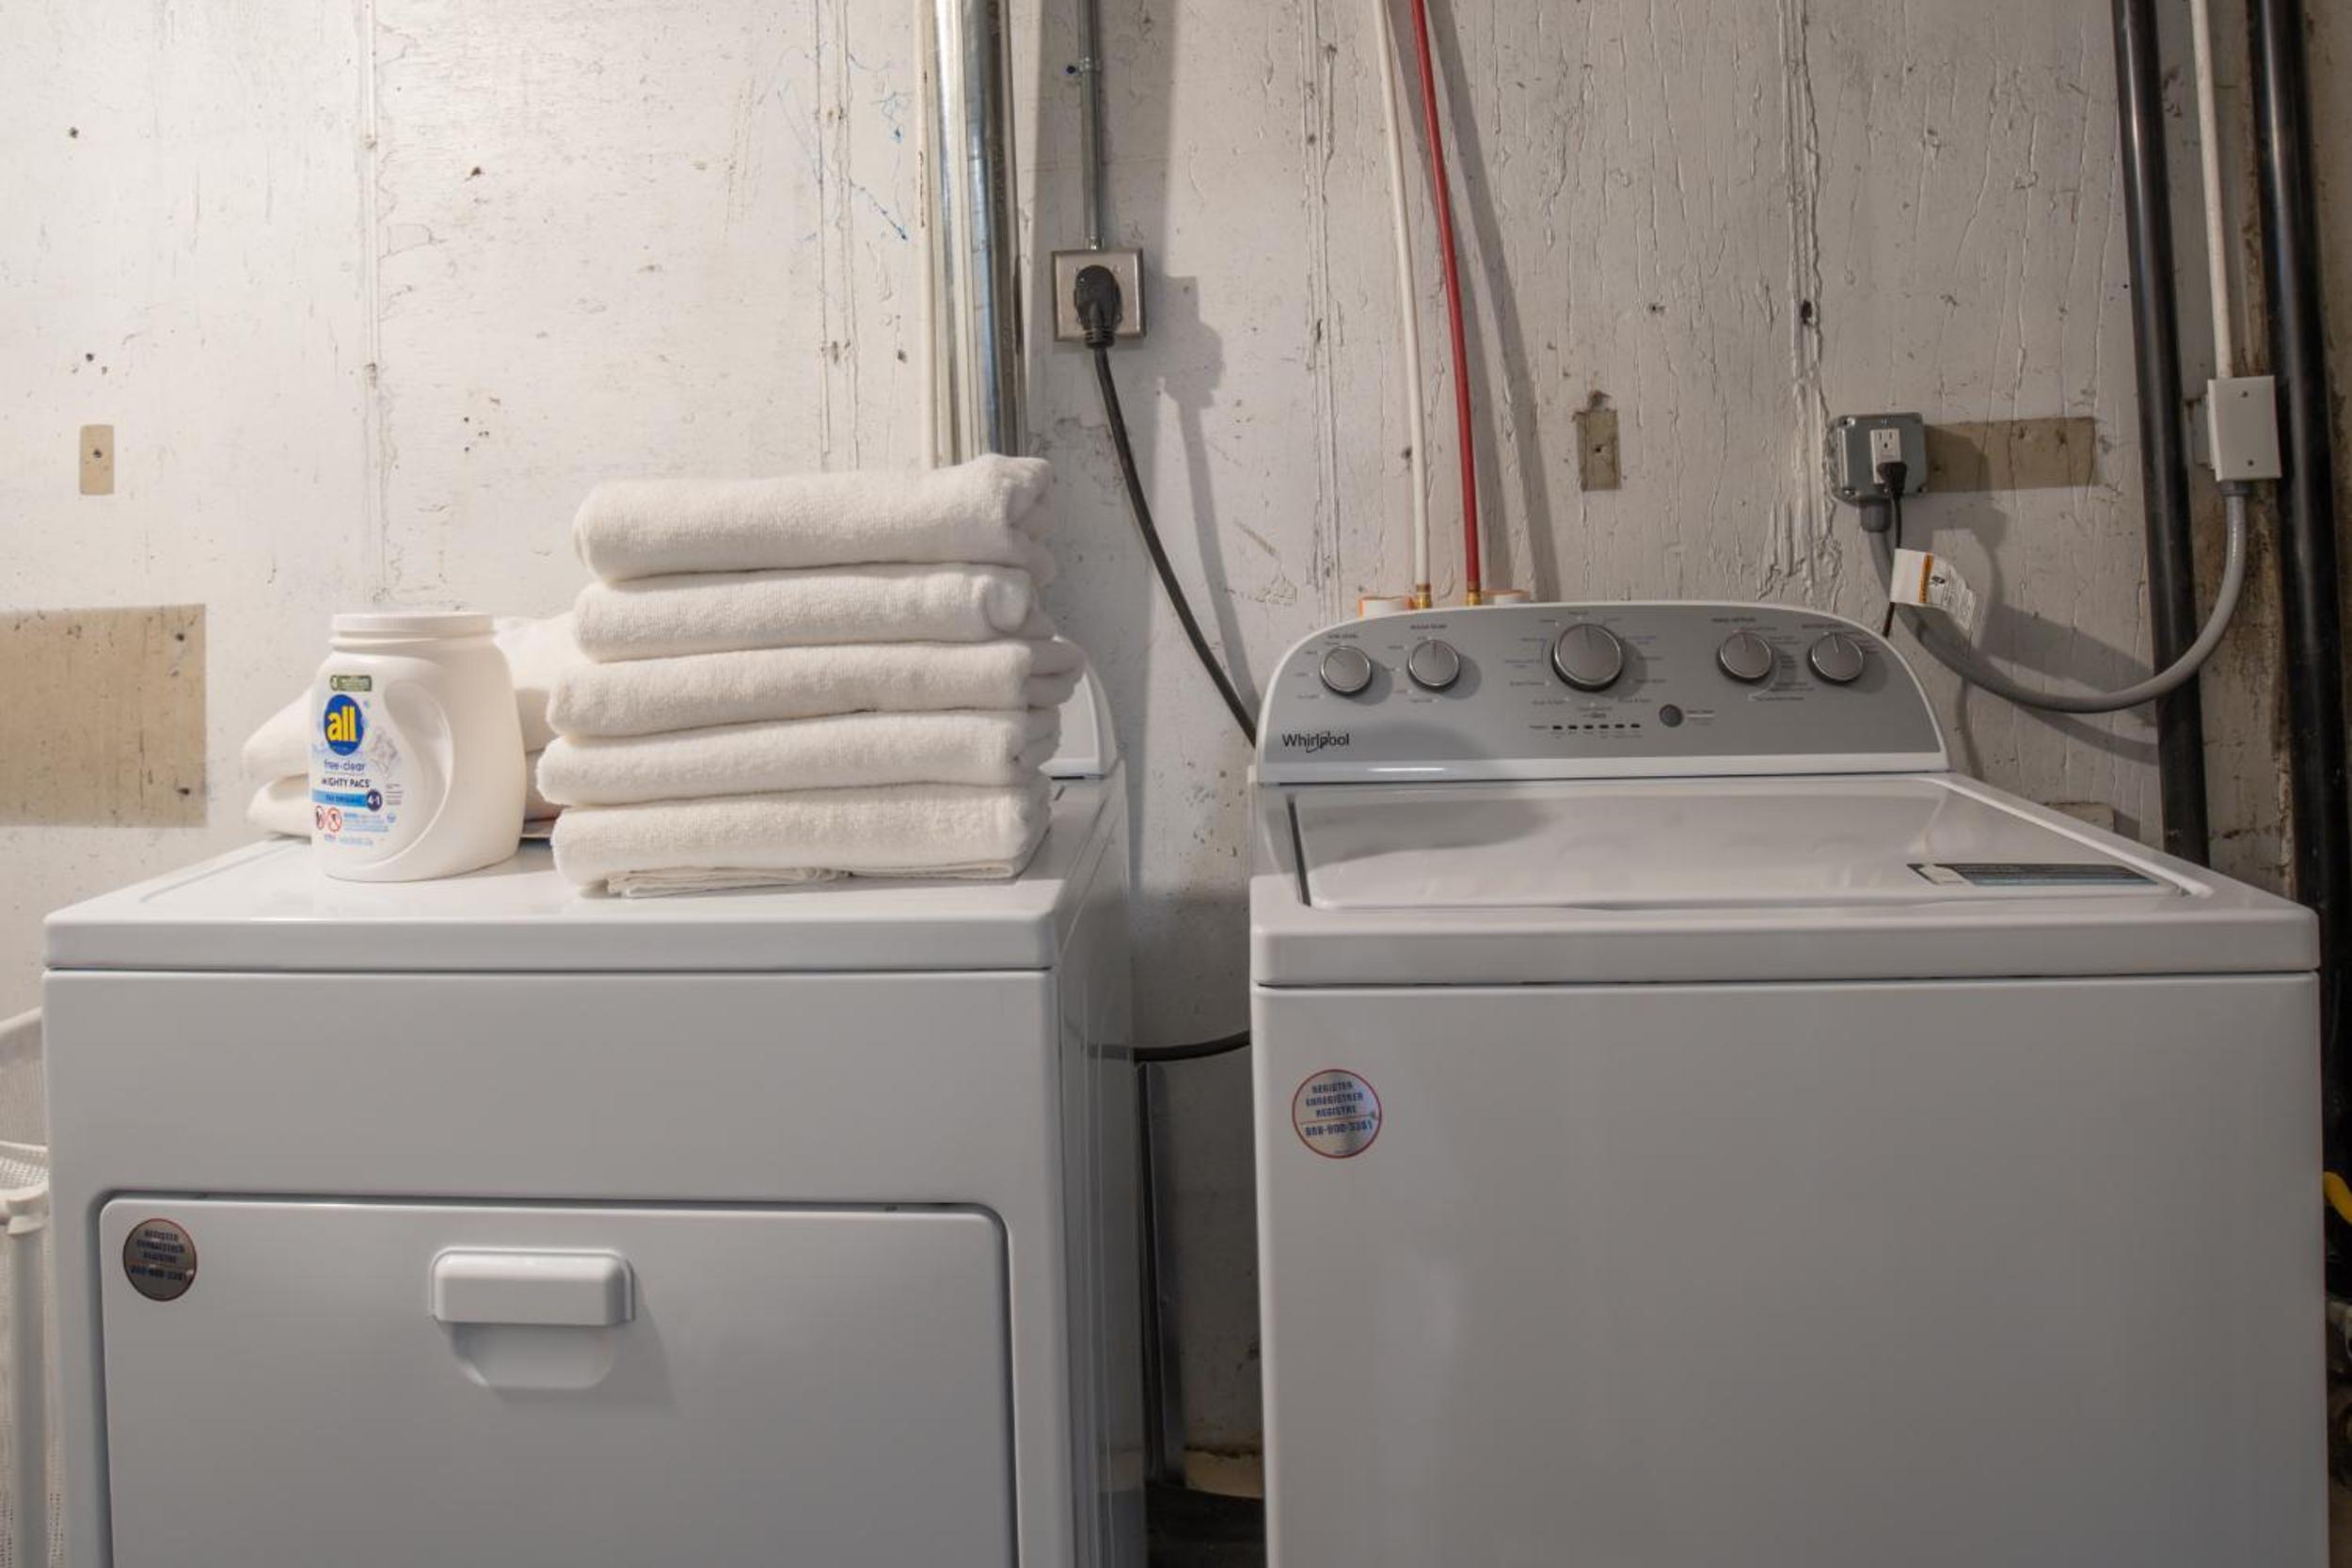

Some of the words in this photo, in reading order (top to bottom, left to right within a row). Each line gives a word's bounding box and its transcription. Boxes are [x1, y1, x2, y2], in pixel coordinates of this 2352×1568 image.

[327, 705, 358, 742] all
[1282, 731, 1349, 752] Whirlpool
[1311, 1081, 1354, 1094] REGISTER
